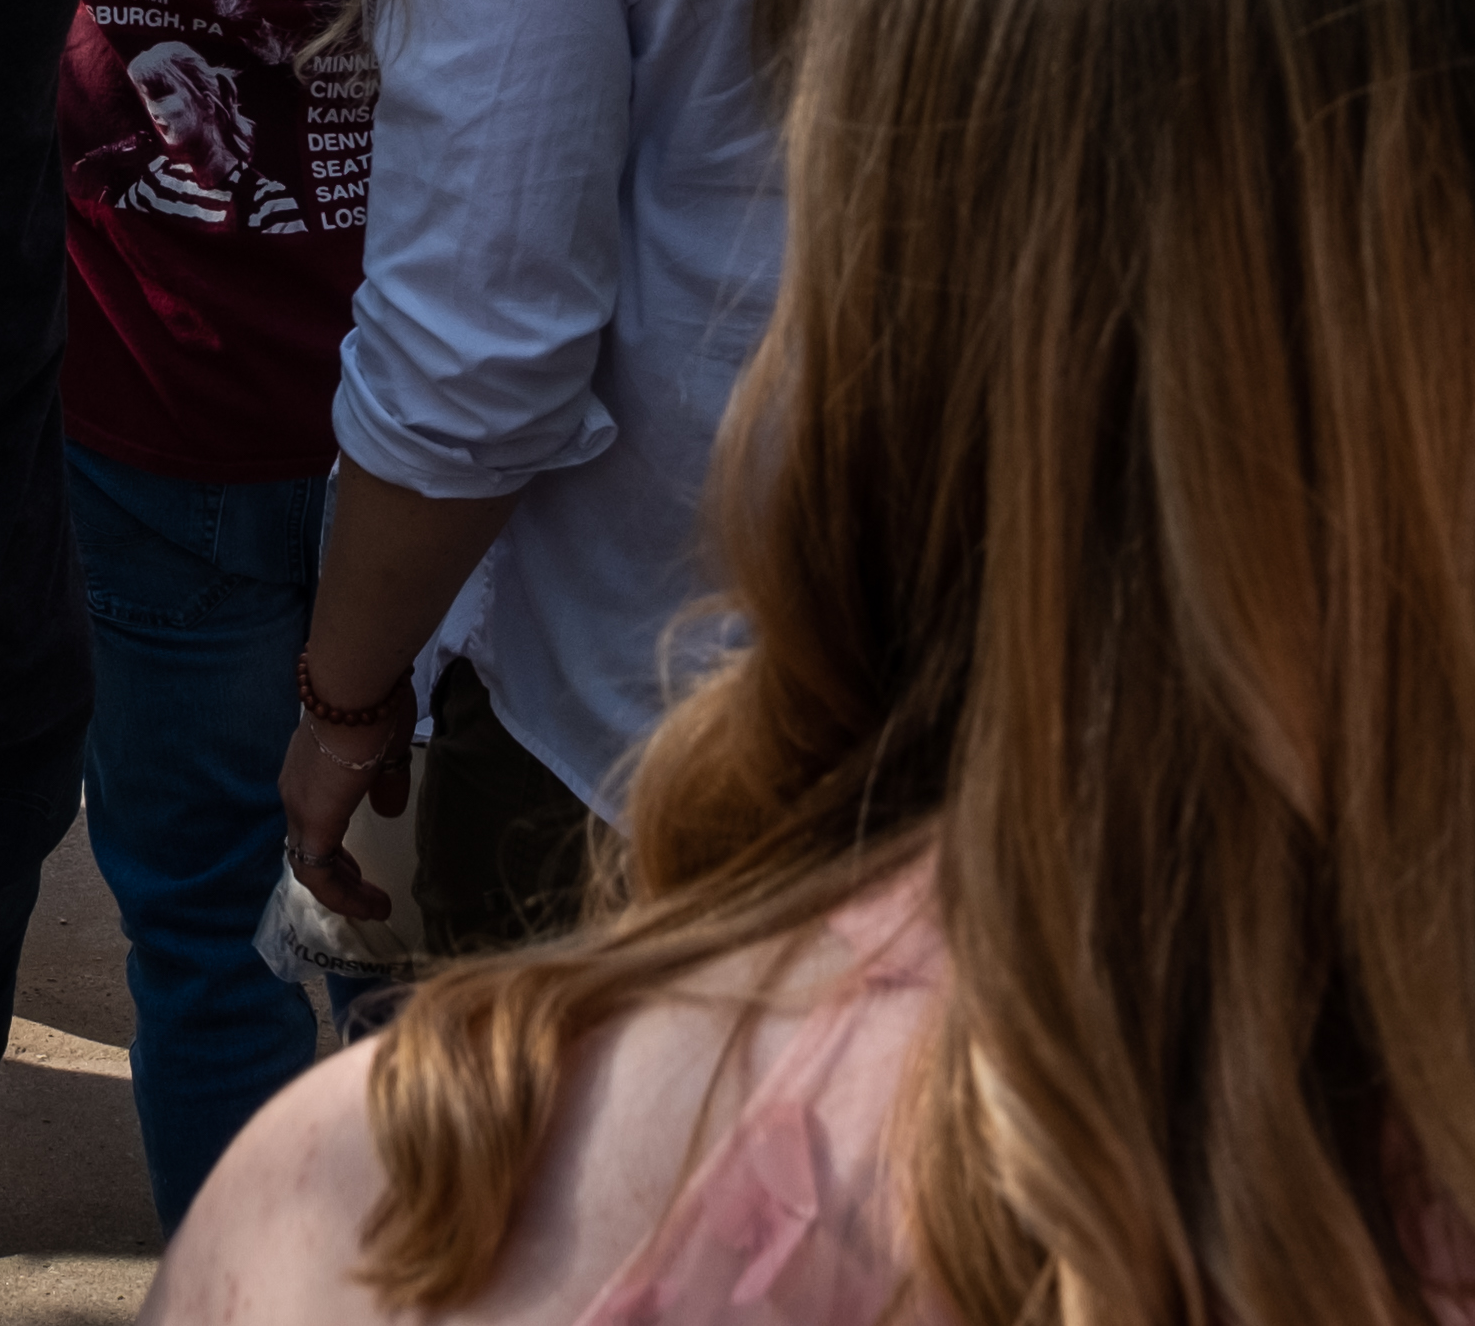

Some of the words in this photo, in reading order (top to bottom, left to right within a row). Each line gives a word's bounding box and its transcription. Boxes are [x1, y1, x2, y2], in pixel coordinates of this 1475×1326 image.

[193, 19, 224, 37] PA
[307, 106, 375, 124] KANS
[307, 130, 374, 152] DENV
[320, 206, 367, 231] LOS
